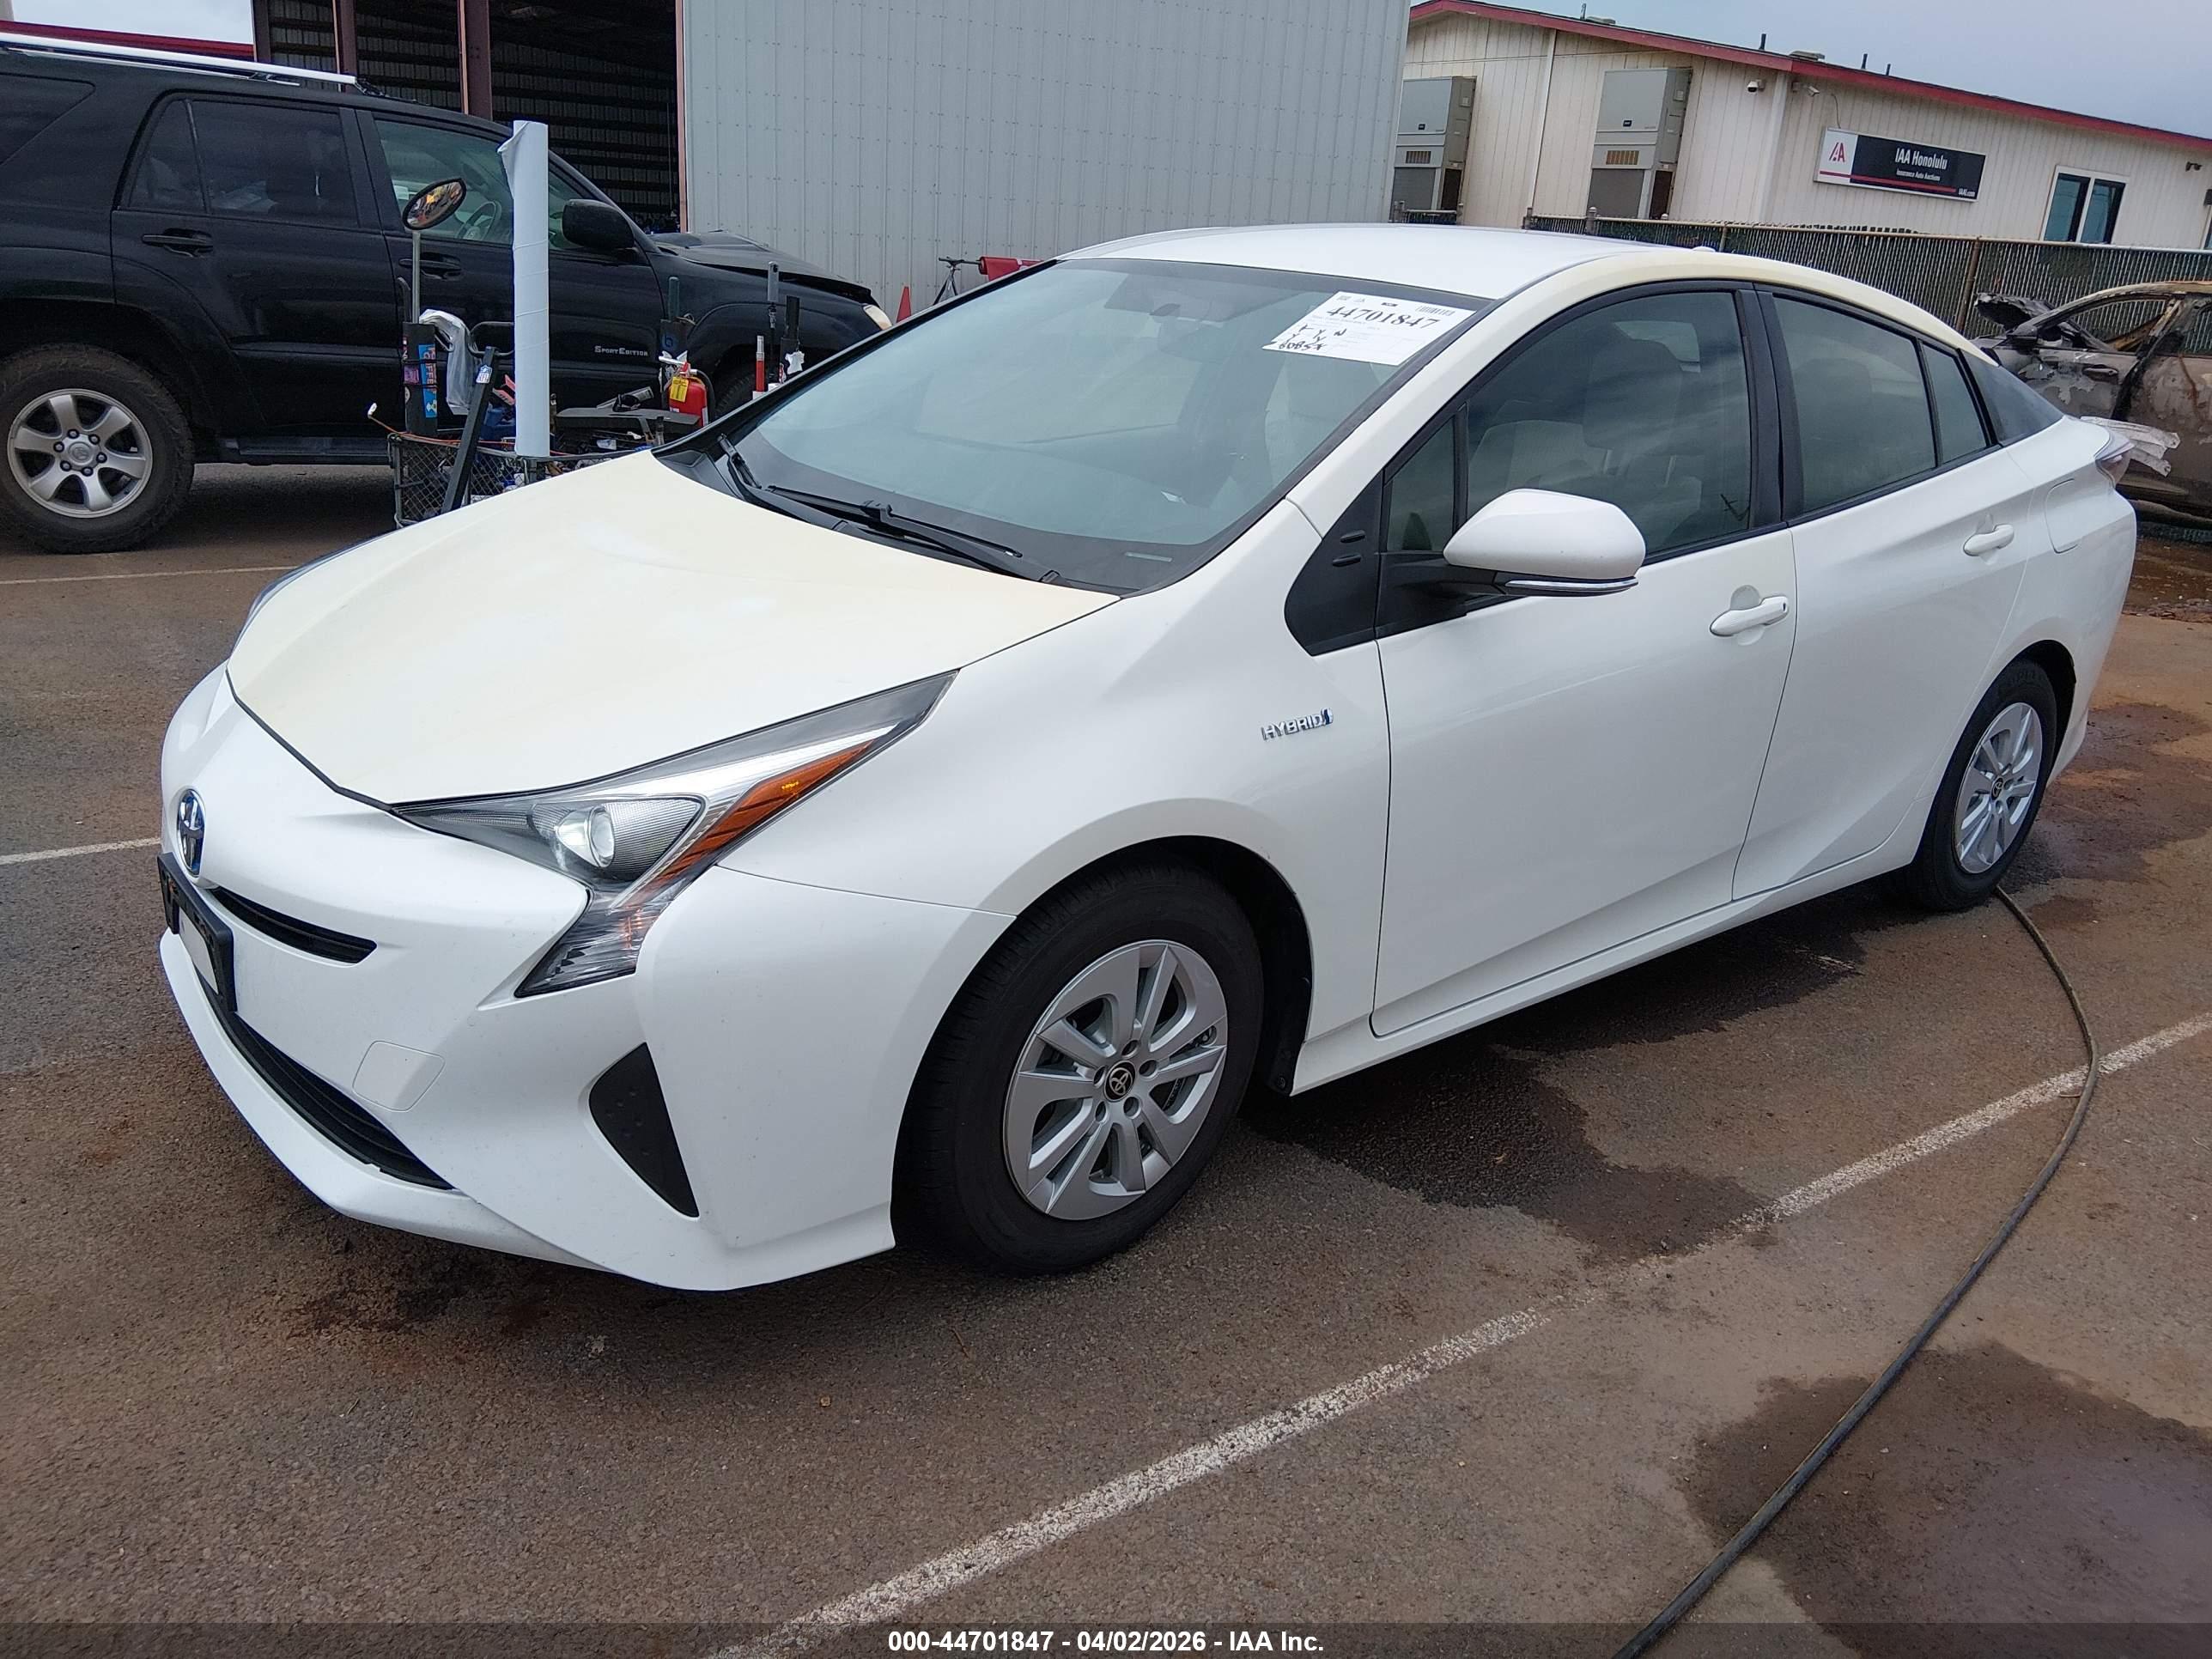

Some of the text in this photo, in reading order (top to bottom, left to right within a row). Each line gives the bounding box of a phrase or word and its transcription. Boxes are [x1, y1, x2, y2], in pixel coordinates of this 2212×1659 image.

[1895, 148, 1948, 170] IAA Honolulu
[1327, 306, 1440, 329] 44701847
[1261, 713, 1323, 740] HYBRID
